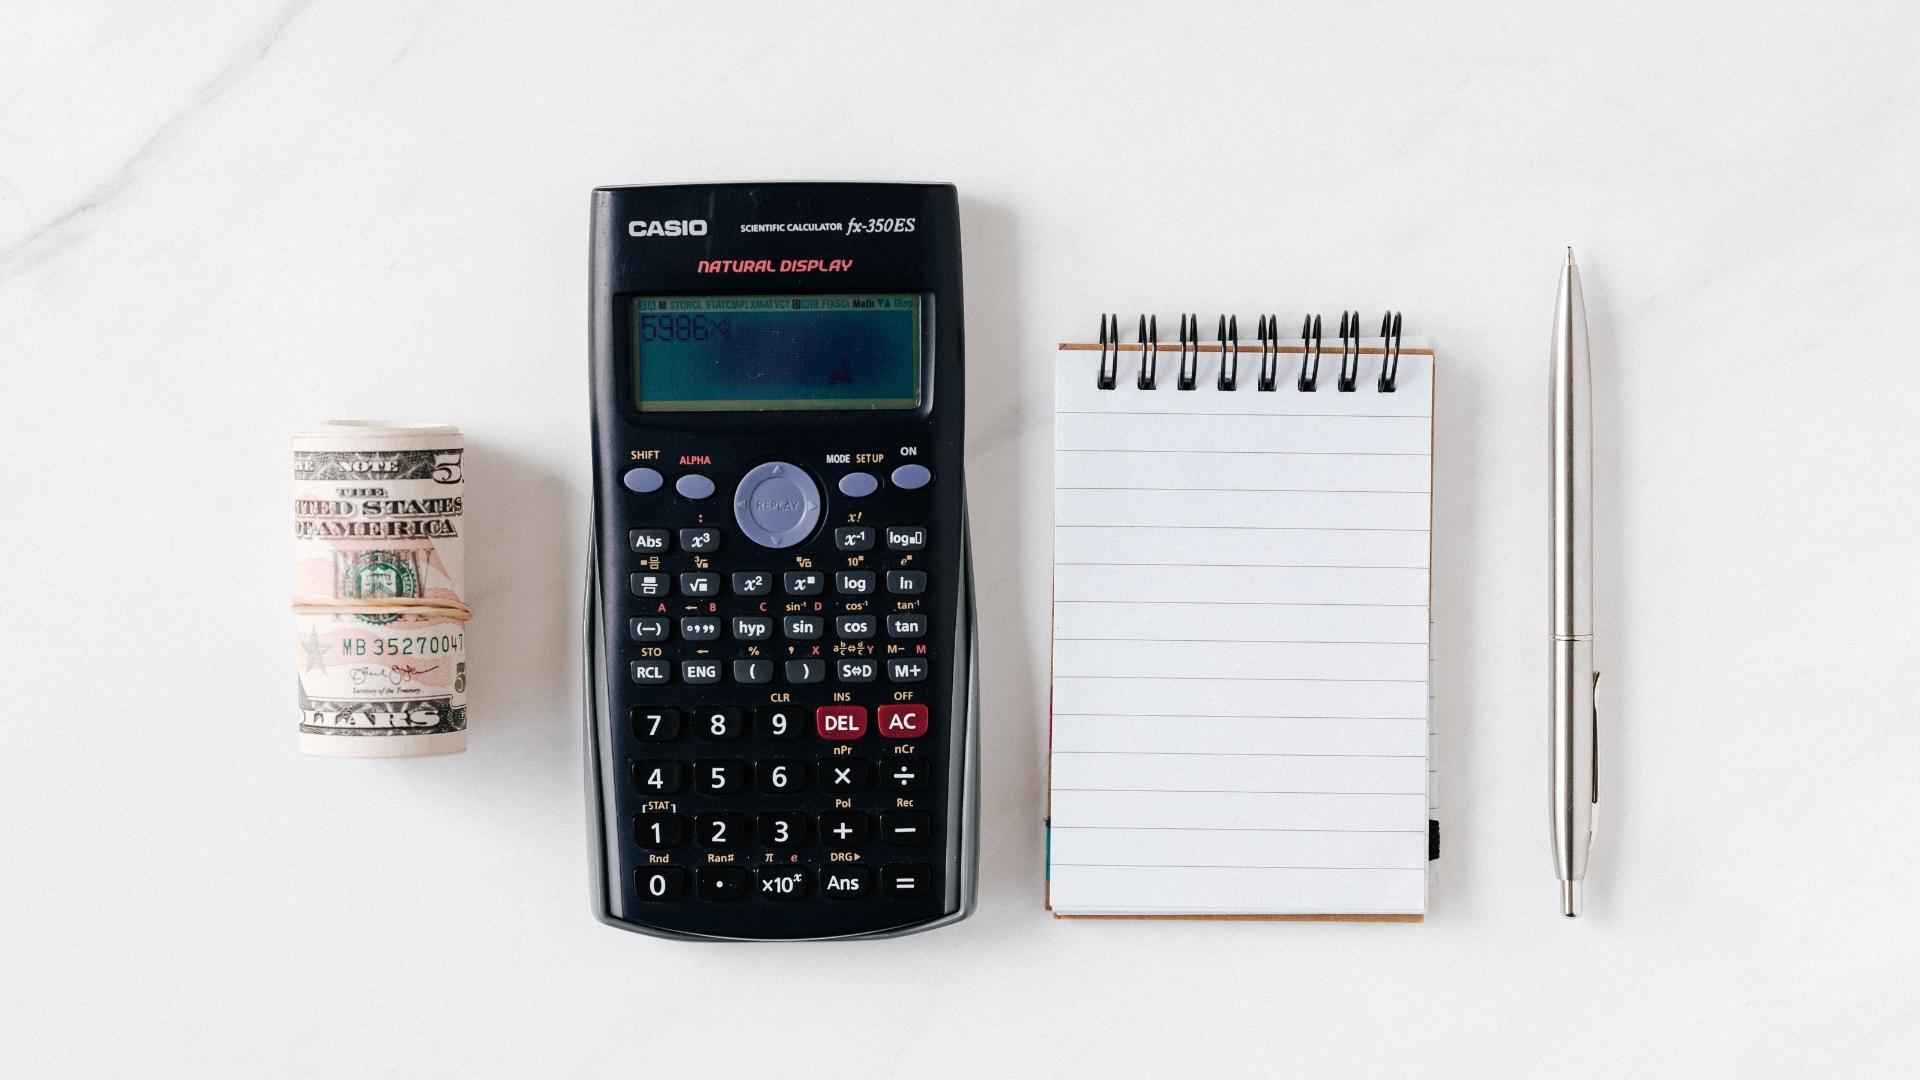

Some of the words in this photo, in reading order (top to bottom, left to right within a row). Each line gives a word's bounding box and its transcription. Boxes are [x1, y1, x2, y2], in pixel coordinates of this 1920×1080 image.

[629, 220, 707, 237] CASIO
[741, 224, 785, 232] SCIENTIFIC
[787, 223, 842, 231] CALCULATOR
[846, 218, 915, 235] fx-350ES
[698, 260, 775, 273] NATURAL
[780, 260, 852, 272] DISPLAY
[852, 299, 875, 308] Math
[631, 451, 660, 459] SHIFT
[901, 447, 916, 456] ON
[680, 456, 711, 464] ALPHA
[827, 454, 850, 463] MODE
[337, 461, 399, 472] NOTE
[362, 496, 462, 518] STATES
[757, 500, 800, 512] REPLAY
[317, 519, 458, 539] AMERICA
[636, 536, 662, 547] Abs
[845, 577, 866, 591] log
[900, 577, 912, 589] ln
[658, 604, 666, 612] A
[710, 603, 716, 611] B
[760, 603, 766, 611] C
[815, 602, 822, 610] D
[740, 621, 765, 636] hyp
[793, 620, 813, 633] sin
[844, 623, 867, 632] cos
[895, 621, 918, 632] tan
[343, 638, 366, 656] MB
[642, 648, 661, 656] STO
[749, 647, 759, 655] %
[813, 646, 819, 654] X
[867, 646, 873, 654] Y
[917, 645, 926, 653] M
[637, 667, 662, 678] RCL
[688, 666, 715, 677] ENG
[895, 665, 921, 677] M+
[771, 693, 789, 702] CLR
[834, 693, 850, 701] INS
[894, 692, 913, 700] OFF
[647, 715, 661, 735] 7
[711, 714, 725, 735] 8
[773, 714, 786, 735] 9
[826, 716, 858, 730] DEL
[889, 713, 915, 729] AC
[834, 746, 852, 754] nPr
[895, 745, 914, 753] nCr
[648, 769, 663, 789] 4
[712, 768, 725, 788] 5
[773, 766, 787, 787] 6
[648, 800, 670, 811] STAT
[836, 798, 851, 807] Pol
[897, 798, 913, 807] Rec
[651, 823, 660, 843] 1
[712, 821, 726, 842] 2
[775, 821, 788, 842] 3
[650, 854, 669, 863] Rnd
[708, 854, 734, 862] Ran#
[831, 853, 852, 861] DRG
[650, 875, 665, 896] 0
[827, 876, 859, 890] Ans
